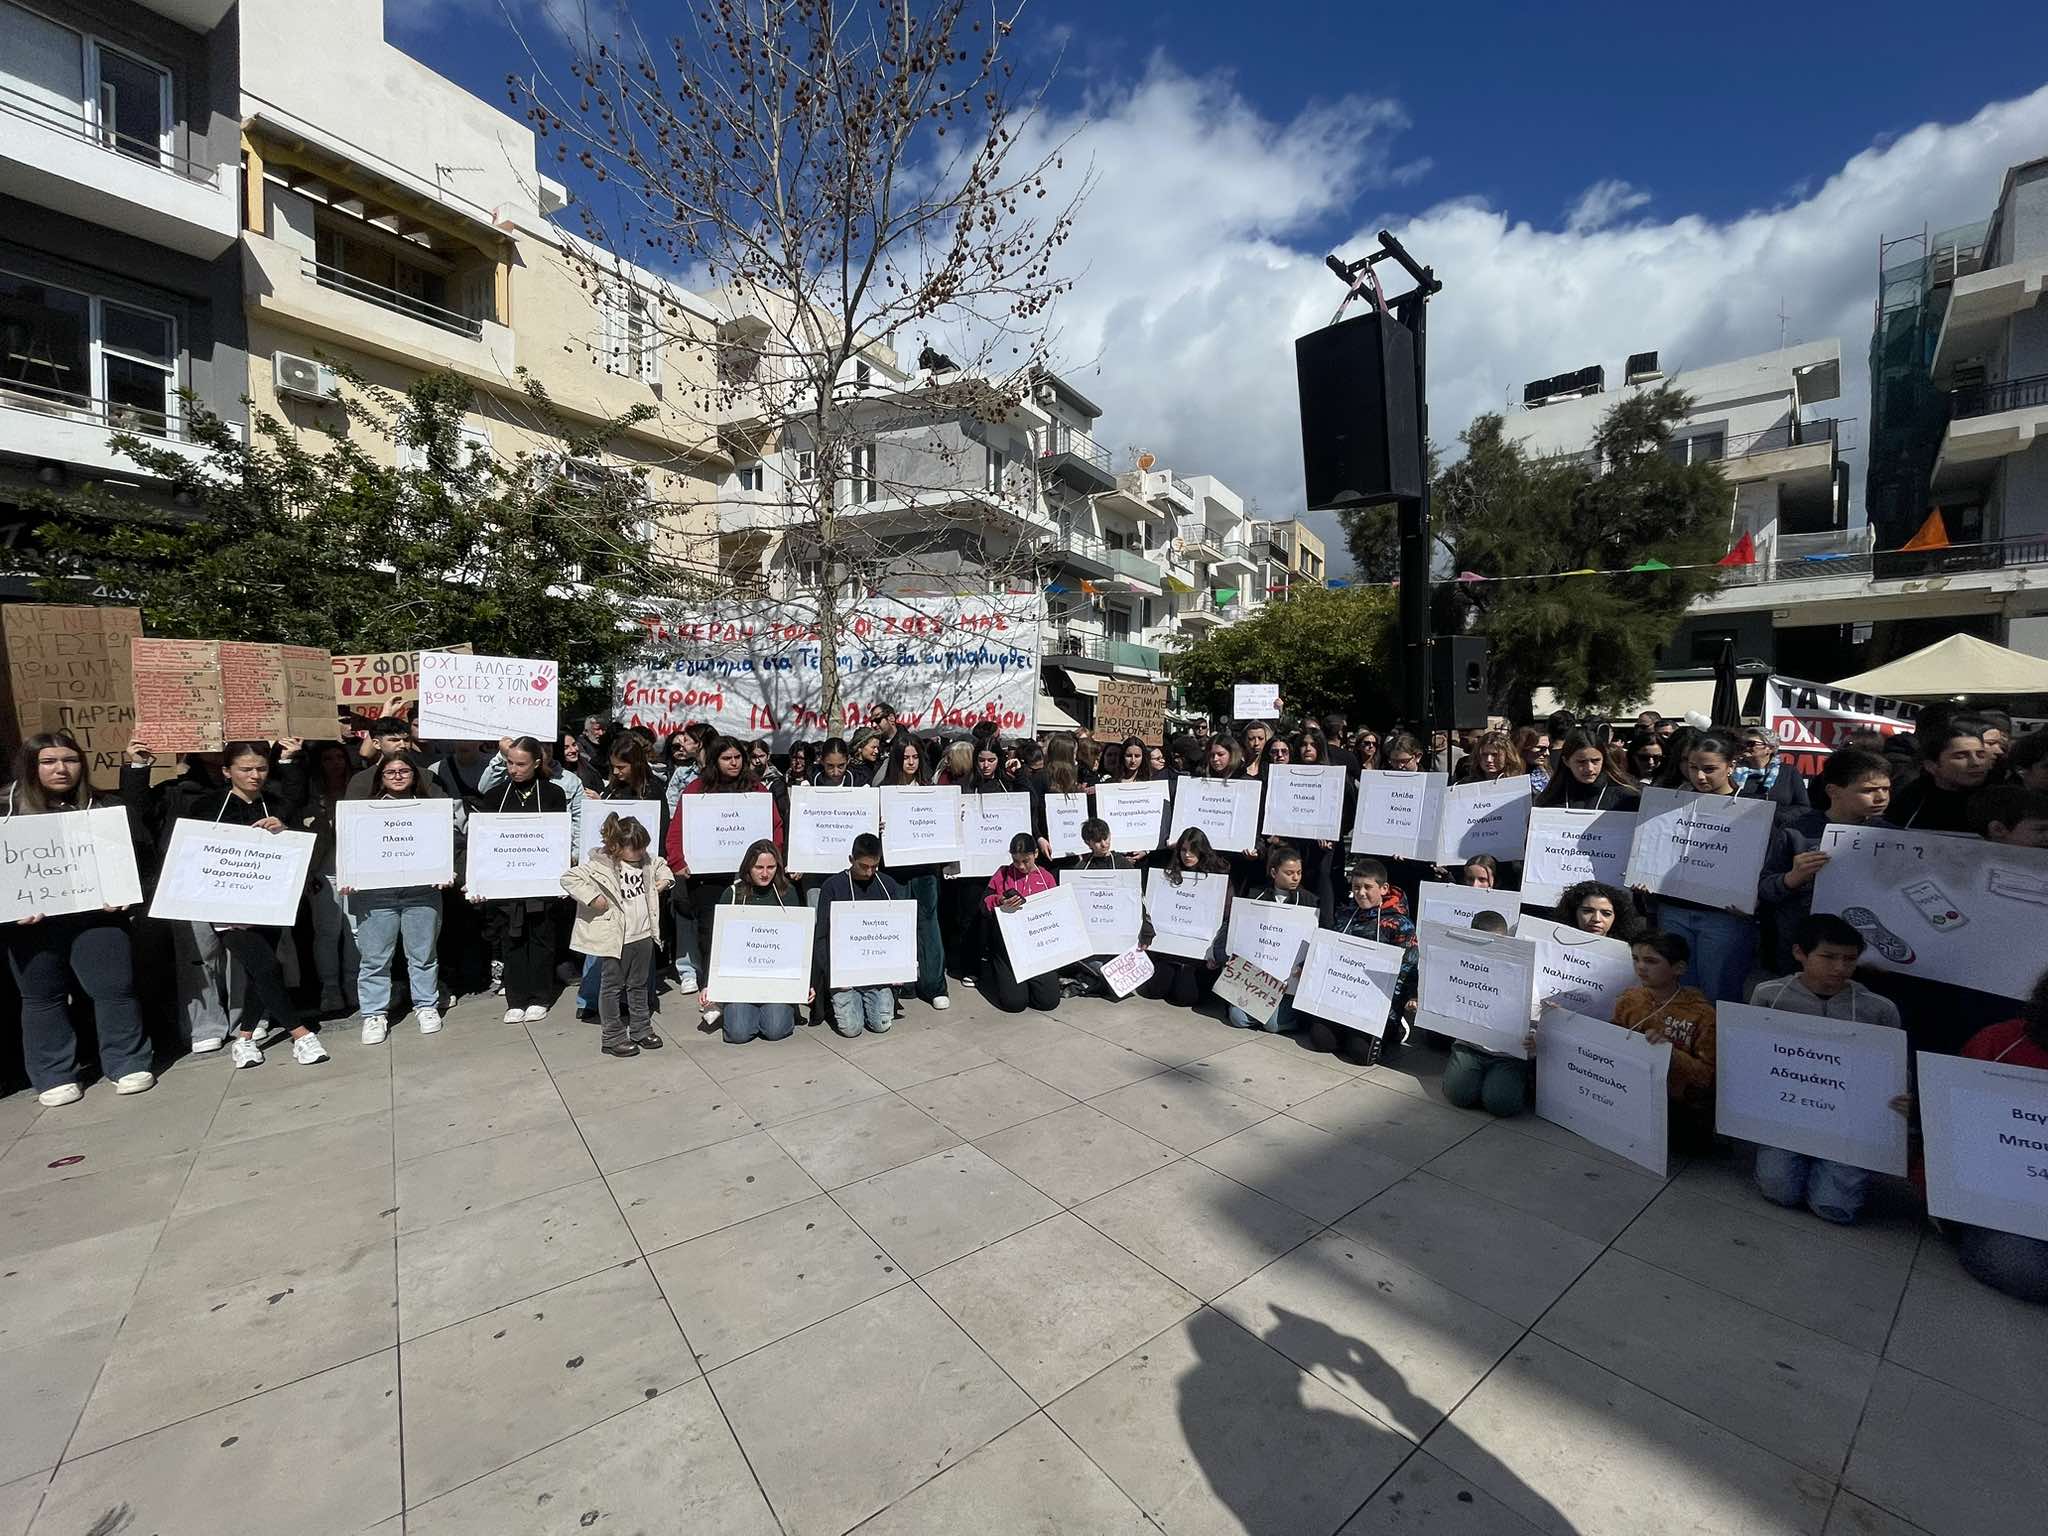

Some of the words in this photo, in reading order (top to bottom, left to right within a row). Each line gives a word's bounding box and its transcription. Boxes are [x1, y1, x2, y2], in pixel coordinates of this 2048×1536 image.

[961, 613, 1009, 631] ΜΑΣ
[331, 657, 367, 675] 57
[423, 656, 457, 670] ΟΧΙ
[475, 662, 525, 676] ΑΛΛΕΣ
[498, 677, 529, 691] ΣΤΟΝ
[425, 691, 466, 704] ΒΩΜΟ
[478, 695, 495, 704] ΤΟΥ
[624, 680, 725, 712] Επιτροπή
[1778, 684, 1819, 710] ΤΑ
[1778, 719, 1823, 744] ΟΧΙ
[1473, 801, 1492, 810] Λένα
[383, 819, 413, 829] Χρύσα
[1676, 818, 1731, 834] Αναστασία
[382, 834, 415, 843] Πλακιά
[499, 831, 545, 840] Αναστάσιος
[1561, 831, 1604, 842] Ελισάβετ
[4, 840, 95, 864] brahim
[1671, 835, 1728, 854] Παπαγγελή
[203, 845, 242, 858] Μάρθη
[244, 848, 283, 861] (Μαρία
[381, 849, 393, 859] 20
[394, 849, 415, 859] ετών
[1544, 846, 1617, 860] Χατζηβασιλείου
[506, 860, 516, 868] 21
[1561, 863, 1572, 872] 26
[1573, 864, 1596, 874] ετών
[1691, 858, 1716, 869] ετών
[202, 867, 272, 881] Ψαροπούλου
[213, 879, 226, 888] 21
[229, 882, 254, 891] ετών
[1453, 908, 1476, 920] Μαρί
[1338, 954, 1367, 969] Γιώργος
[1459, 959, 1489, 974] Μαρία
[1562, 952, 1592, 969] Νίκος
[1449, 975, 1499, 996] Μουρτζάκη
[1542, 966, 1605, 992] Ναλμπάντης
[1549, 986, 1563, 997] 27
[1455, 994, 1466, 1005] 51
[1467, 997, 1490, 1011] ετών
[1576, 1046, 1615, 1069] Γιώργος
[1773, 1043, 1841, 1066] Ιορδάνης
[1567, 1062, 1629, 1094] Φωτόπουλος
[1769, 1066, 1846, 1091] Αδαμάκης
[1578, 1085, 1591, 1097] 57
[1591, 1092, 1615, 1107] ετών
[1779, 1091, 1796, 1104] 22
[1800, 1096, 1836, 1112] ετών
[2011, 1108, 2048, 1126] Βαγ
[2026, 1165, 2048, 1180] 54
